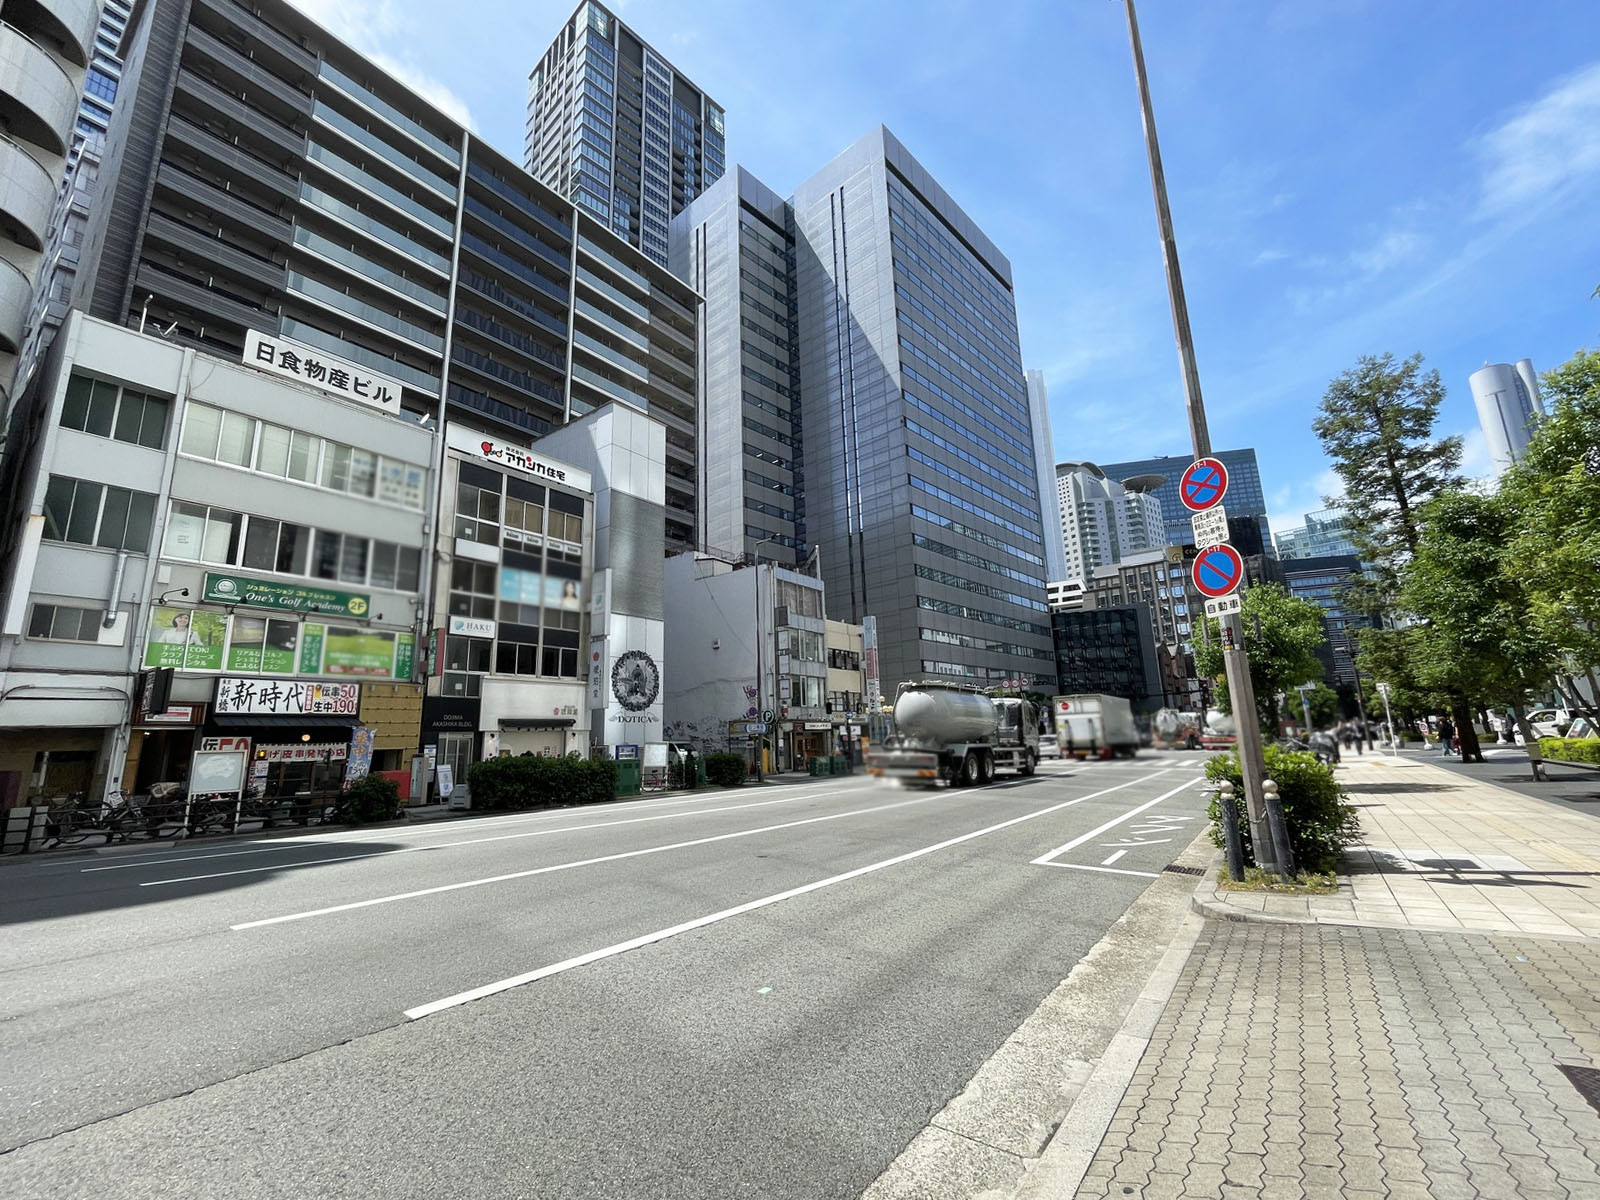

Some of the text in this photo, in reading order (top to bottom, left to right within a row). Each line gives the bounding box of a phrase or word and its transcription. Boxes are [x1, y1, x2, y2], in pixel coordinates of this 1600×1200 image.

[256, 341, 393, 403] 日食物産ビル
[505, 452, 566, 481] アカシカ住宅
[245, 592, 345, 612] One's Golf Academy
[350, 601, 365, 610] 2F
[1207, 599, 1239, 615] 自動車
[466, 622, 492, 631] HAKU
[230, 680, 304, 713] 新時代
[432, 720, 458, 728] AKASHIKA
